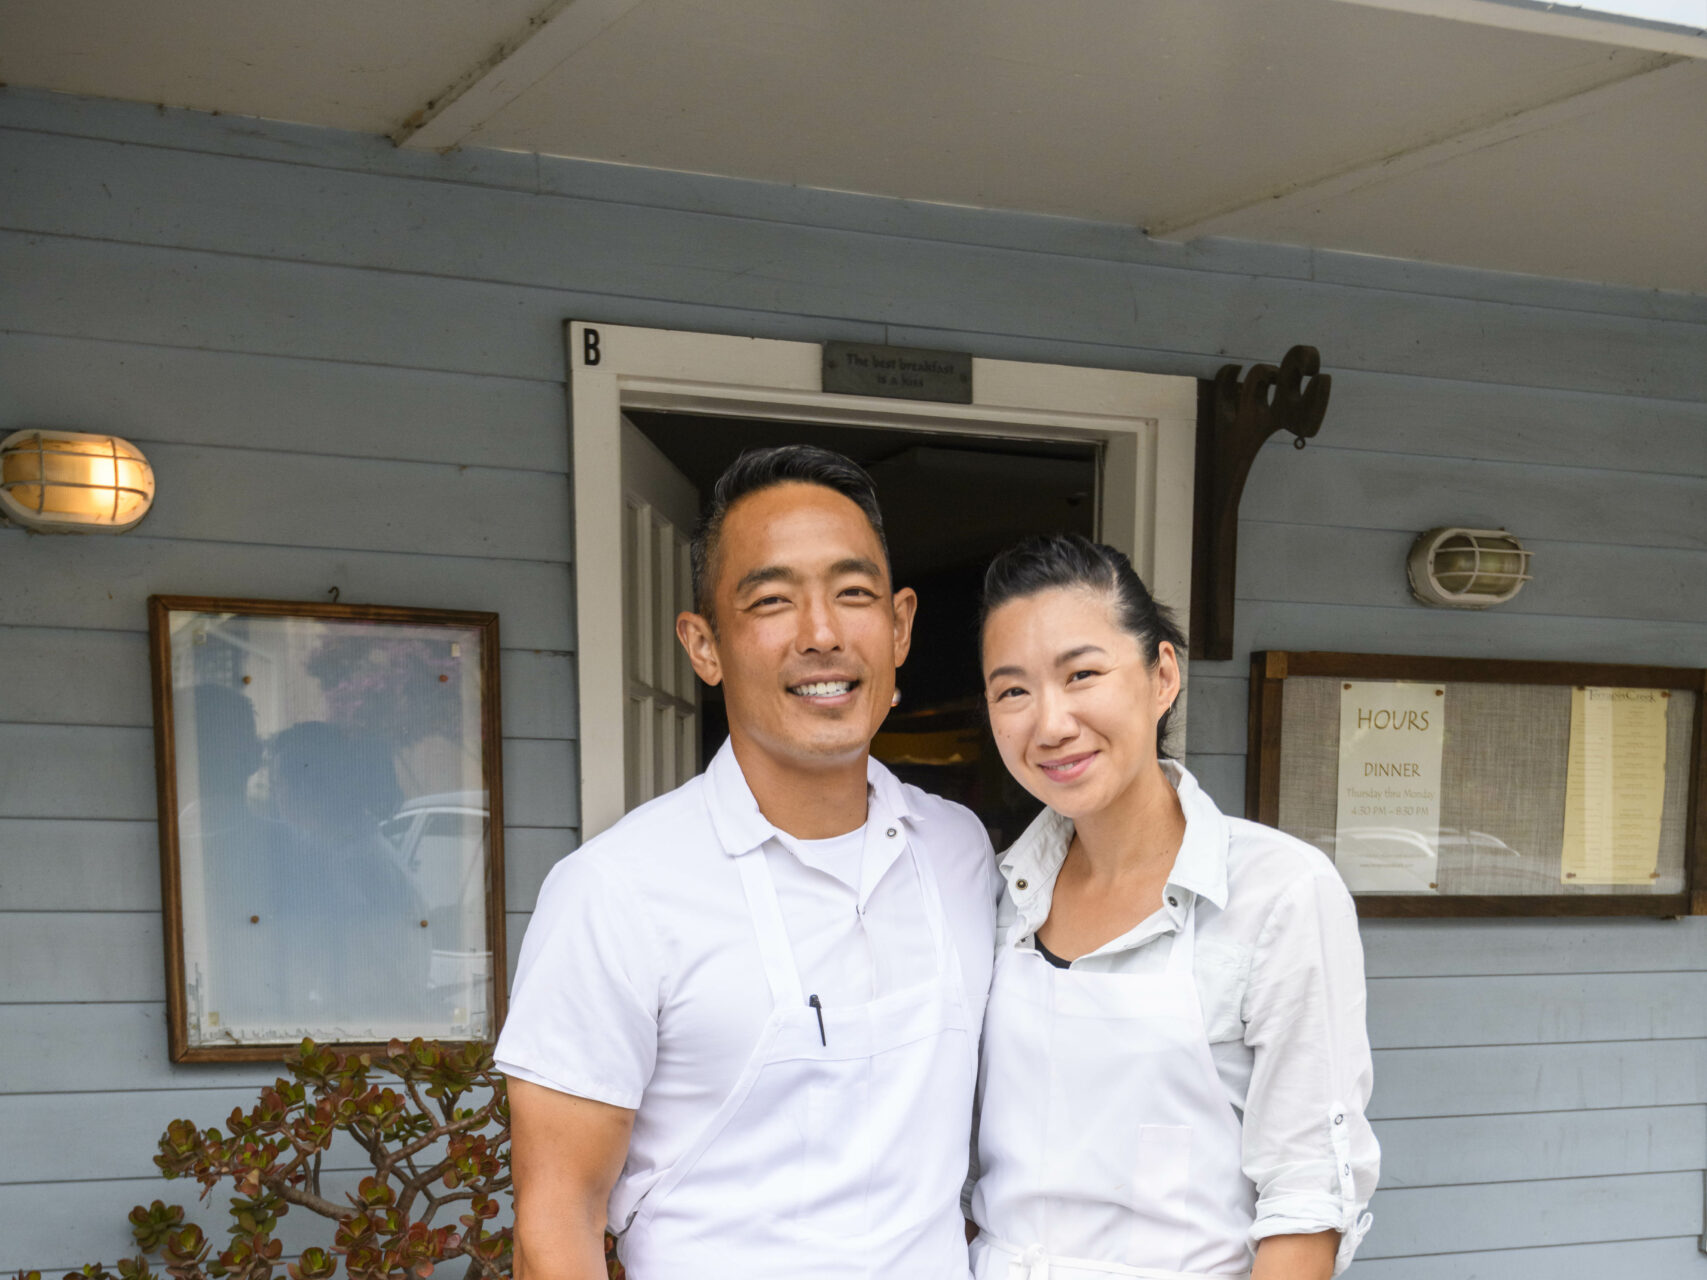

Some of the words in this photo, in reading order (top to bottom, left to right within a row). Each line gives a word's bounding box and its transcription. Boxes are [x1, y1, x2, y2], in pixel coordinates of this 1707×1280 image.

[583, 328, 601, 366] B
[847, 353, 868, 367] The
[873, 355, 896, 369] best
[899, 358, 954, 374] breakfast
[1357, 708, 1430, 731] HOURS
[1364, 762, 1421, 777] DINNER
[1347, 787, 1382, 800] Thursday
[1403, 788, 1435, 801] Monday
[1373, 806, 1387, 816] PM
[1416, 806, 1429, 816] PM
